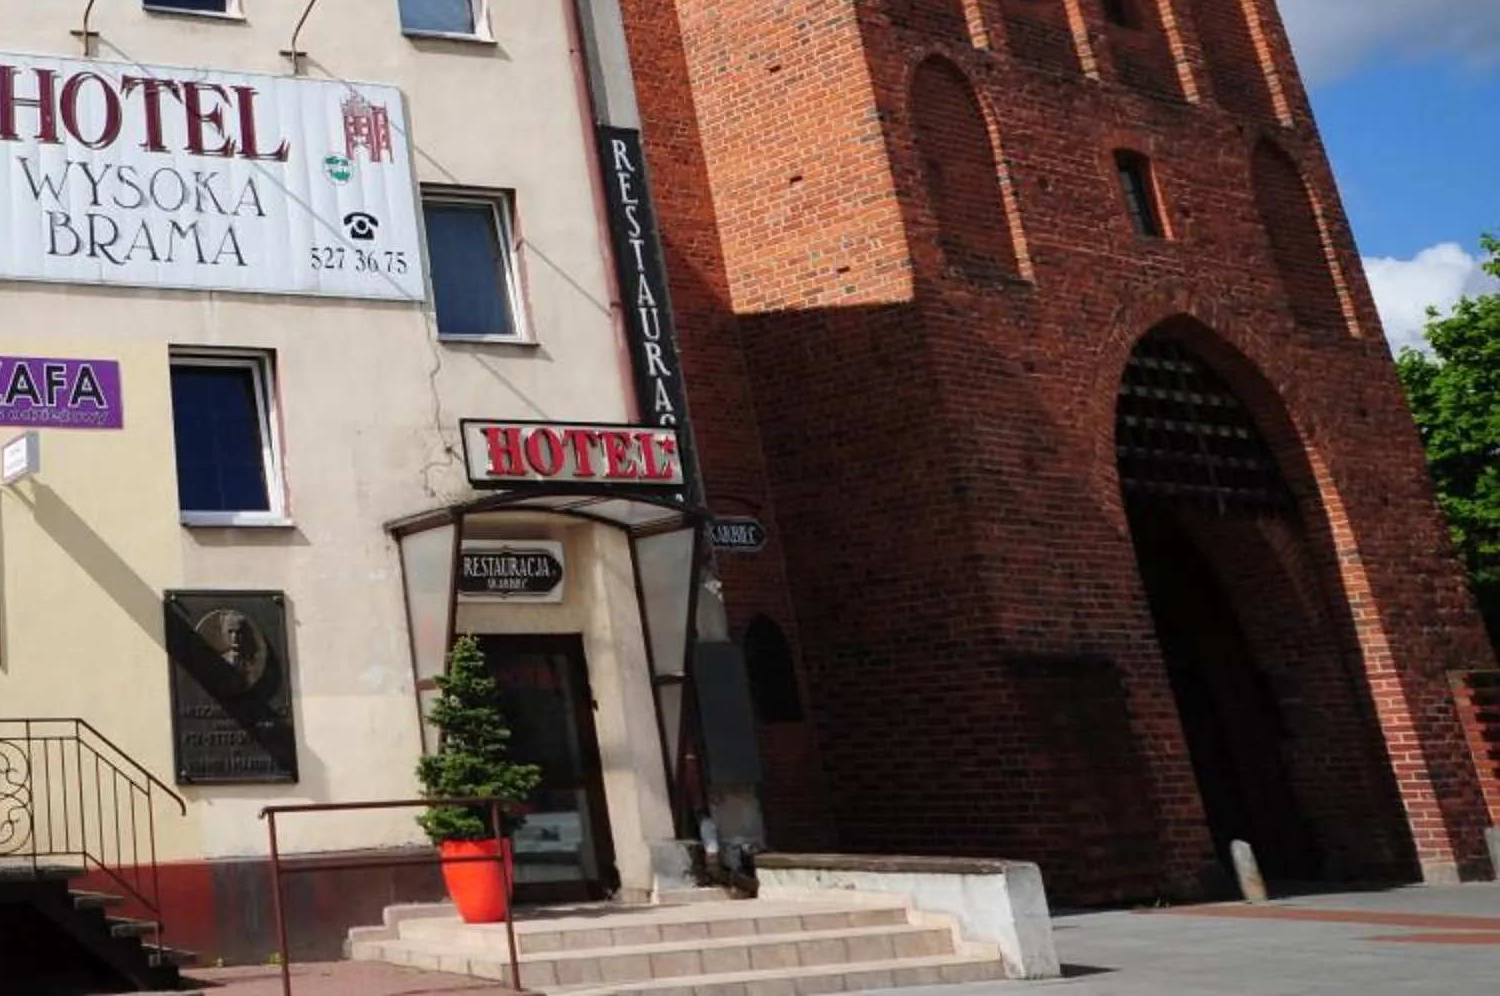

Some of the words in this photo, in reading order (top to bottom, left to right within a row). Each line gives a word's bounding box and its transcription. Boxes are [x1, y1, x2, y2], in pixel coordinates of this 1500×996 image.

[15, 156, 267, 218] WYSOKA
[45, 210, 248, 267] BRAMA
[311, 247, 345, 270] 527
[355, 249, 380, 272] 36
[384, 251, 408, 274] 75
[480, 426, 674, 479] HOTEL
[463, 555, 550, 577] RESTAURACJA
